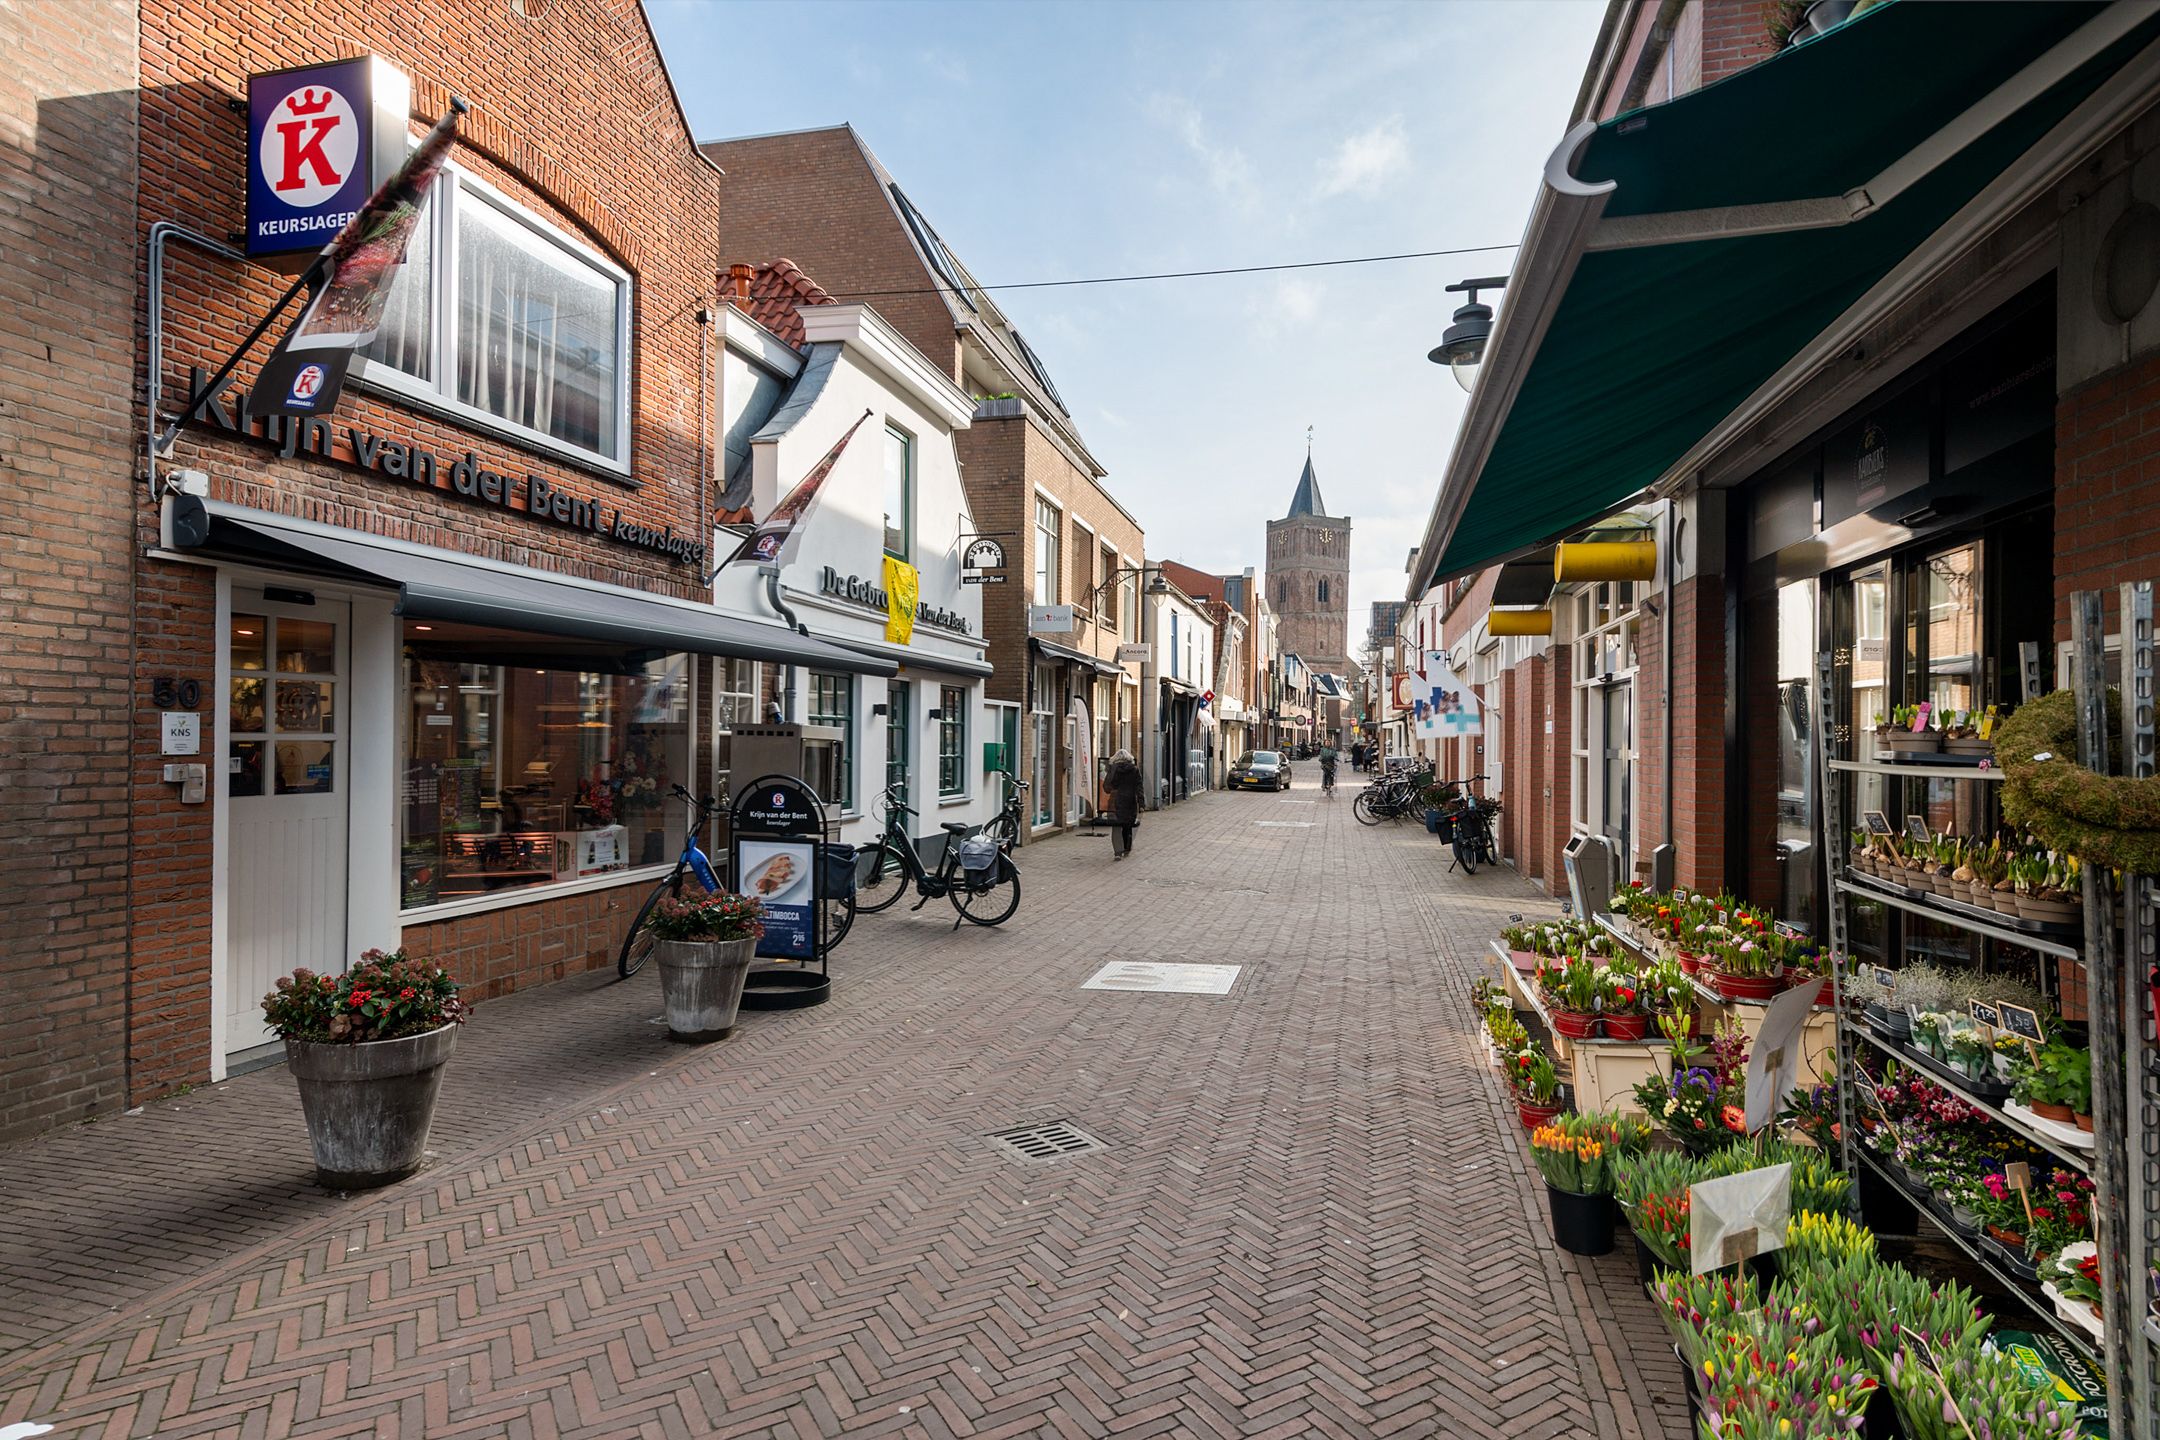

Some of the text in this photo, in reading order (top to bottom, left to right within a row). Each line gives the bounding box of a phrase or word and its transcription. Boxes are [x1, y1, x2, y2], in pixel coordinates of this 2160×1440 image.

[276, 115, 341, 191] K
[296, 374, 319, 394] K
[350, 428, 437, 486] van
[450, 452, 517, 506] der
[528, 474, 607, 533] Bent
[823, 565, 846, 596] De
[978, 575, 989, 583] der
[990, 575, 1004, 583] Bent
[153, 677, 200, 708] 50
[170, 728, 191, 737] KNS
[750, 811, 765, 819] Krijn
[757, 910, 800, 920] LTIMBOCCA
